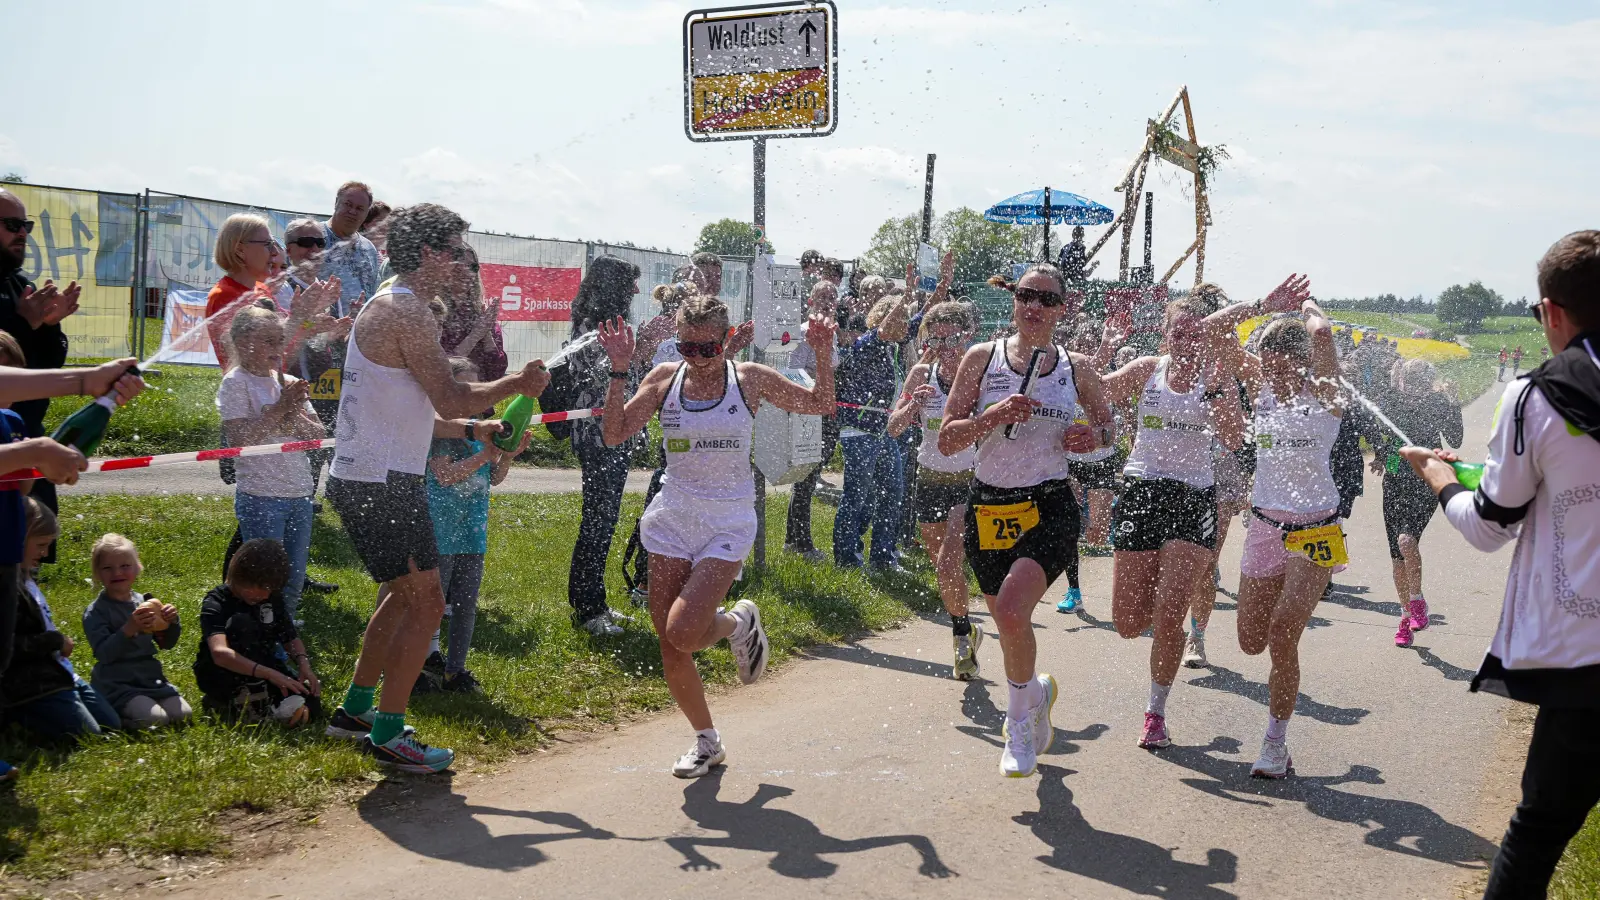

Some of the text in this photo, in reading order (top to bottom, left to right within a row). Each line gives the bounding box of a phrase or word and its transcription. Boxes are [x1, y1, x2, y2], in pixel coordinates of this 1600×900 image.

[707, 21, 785, 50] Waldlust
[731, 55, 761, 69] 2 km
[313, 375, 335, 395] 234
[343, 371, 358, 382] ERG
[1032, 407, 1070, 422] MBERG
[695, 440, 740, 449] AMBERG
[992, 517, 1023, 540] 25
[1303, 540, 1332, 562] 25
